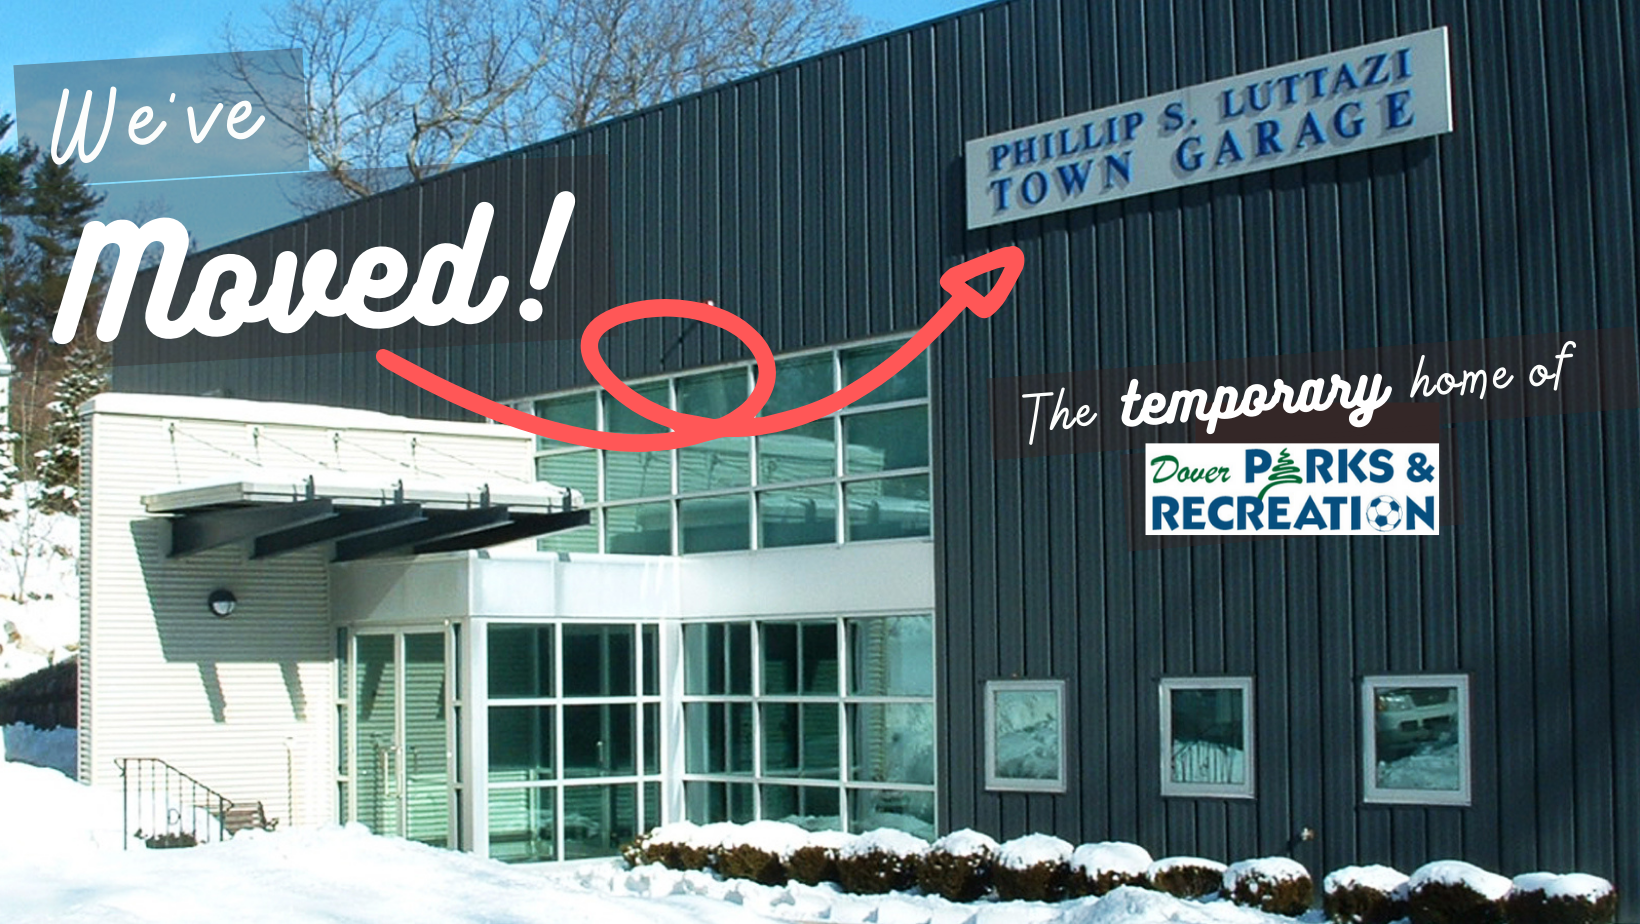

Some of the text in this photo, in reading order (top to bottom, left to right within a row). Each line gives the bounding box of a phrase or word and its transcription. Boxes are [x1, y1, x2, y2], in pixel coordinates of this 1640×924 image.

[989, 89, 1416, 213] TOWN GARAGE
[990, 47, 1412, 171] PHILLIP S. LUTTAZI
